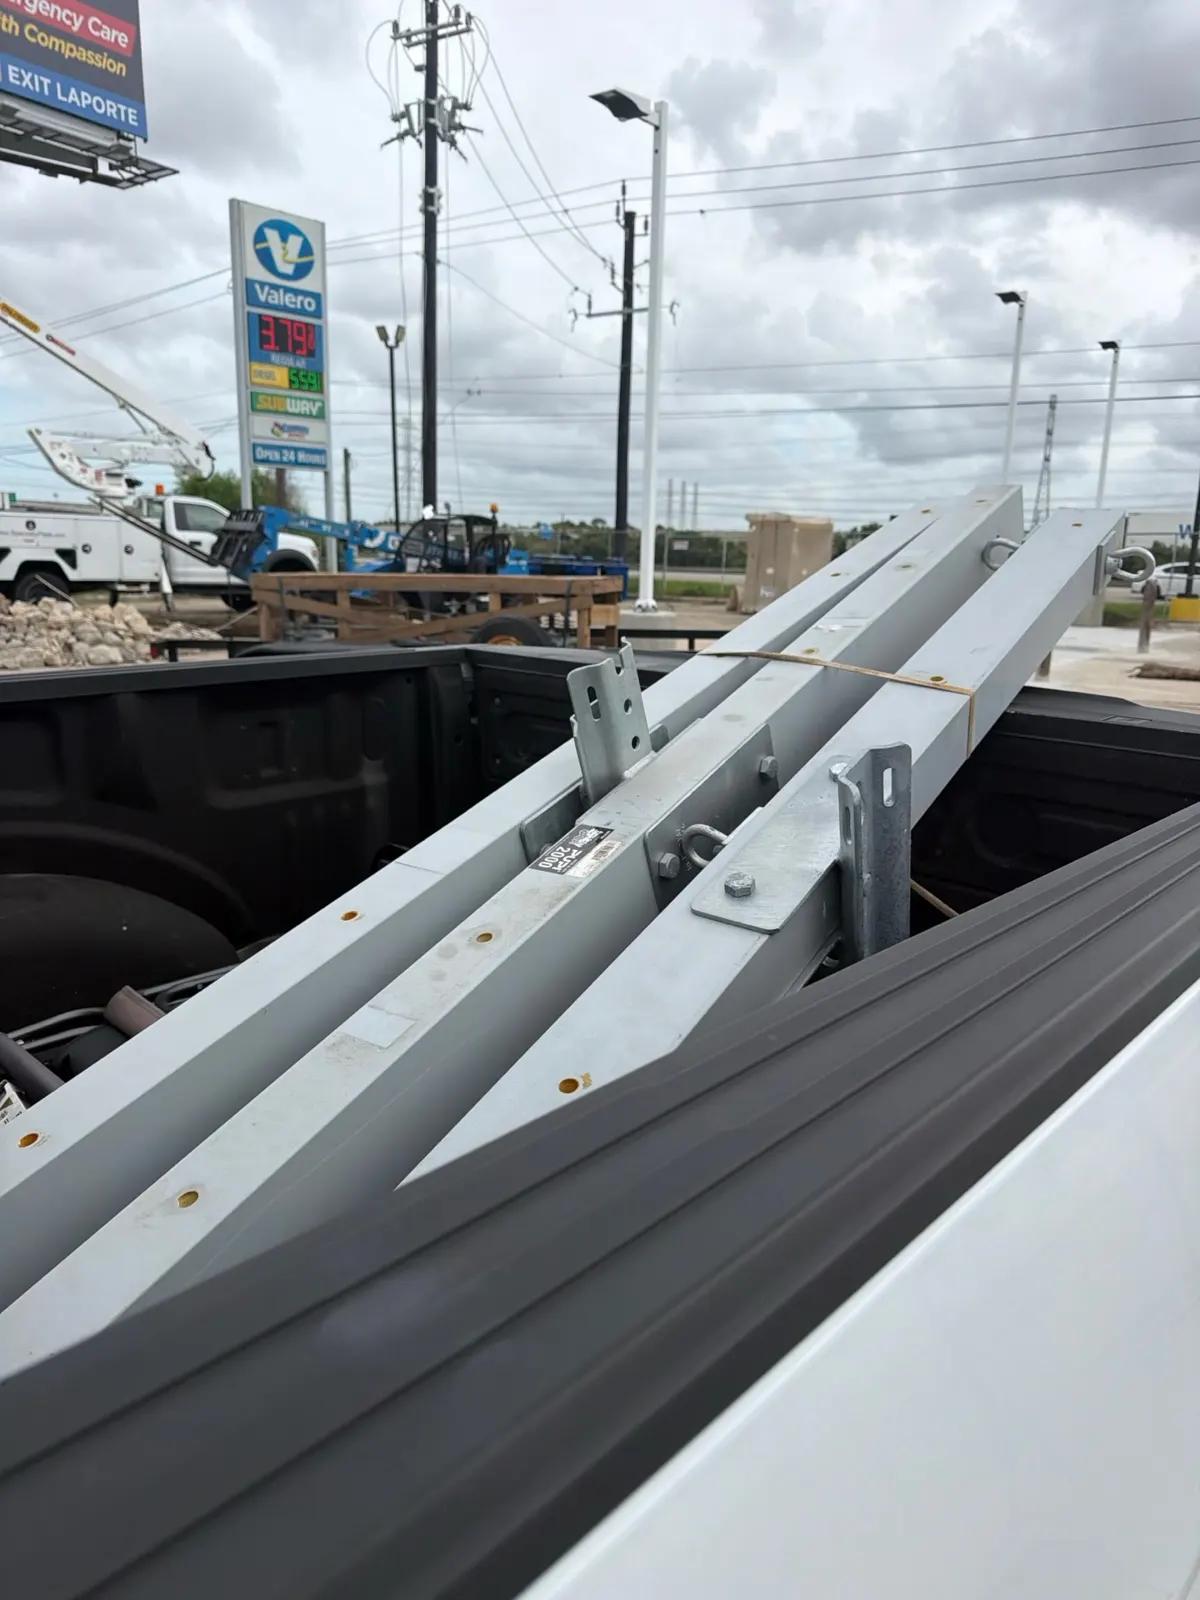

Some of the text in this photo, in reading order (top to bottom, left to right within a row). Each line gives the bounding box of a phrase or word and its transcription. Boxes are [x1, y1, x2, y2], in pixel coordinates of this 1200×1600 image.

[8, 0, 129, 48] gency Care
[24, 22, 127, 78] Compassion
[7, 64, 139, 127] EXIT LAPORTE
[254, 281, 317, 313] Valero
[256, 395, 323, 417] SUBWAY
[281, 448, 296, 463] 24
[538, 846, 571, 868] 2000
